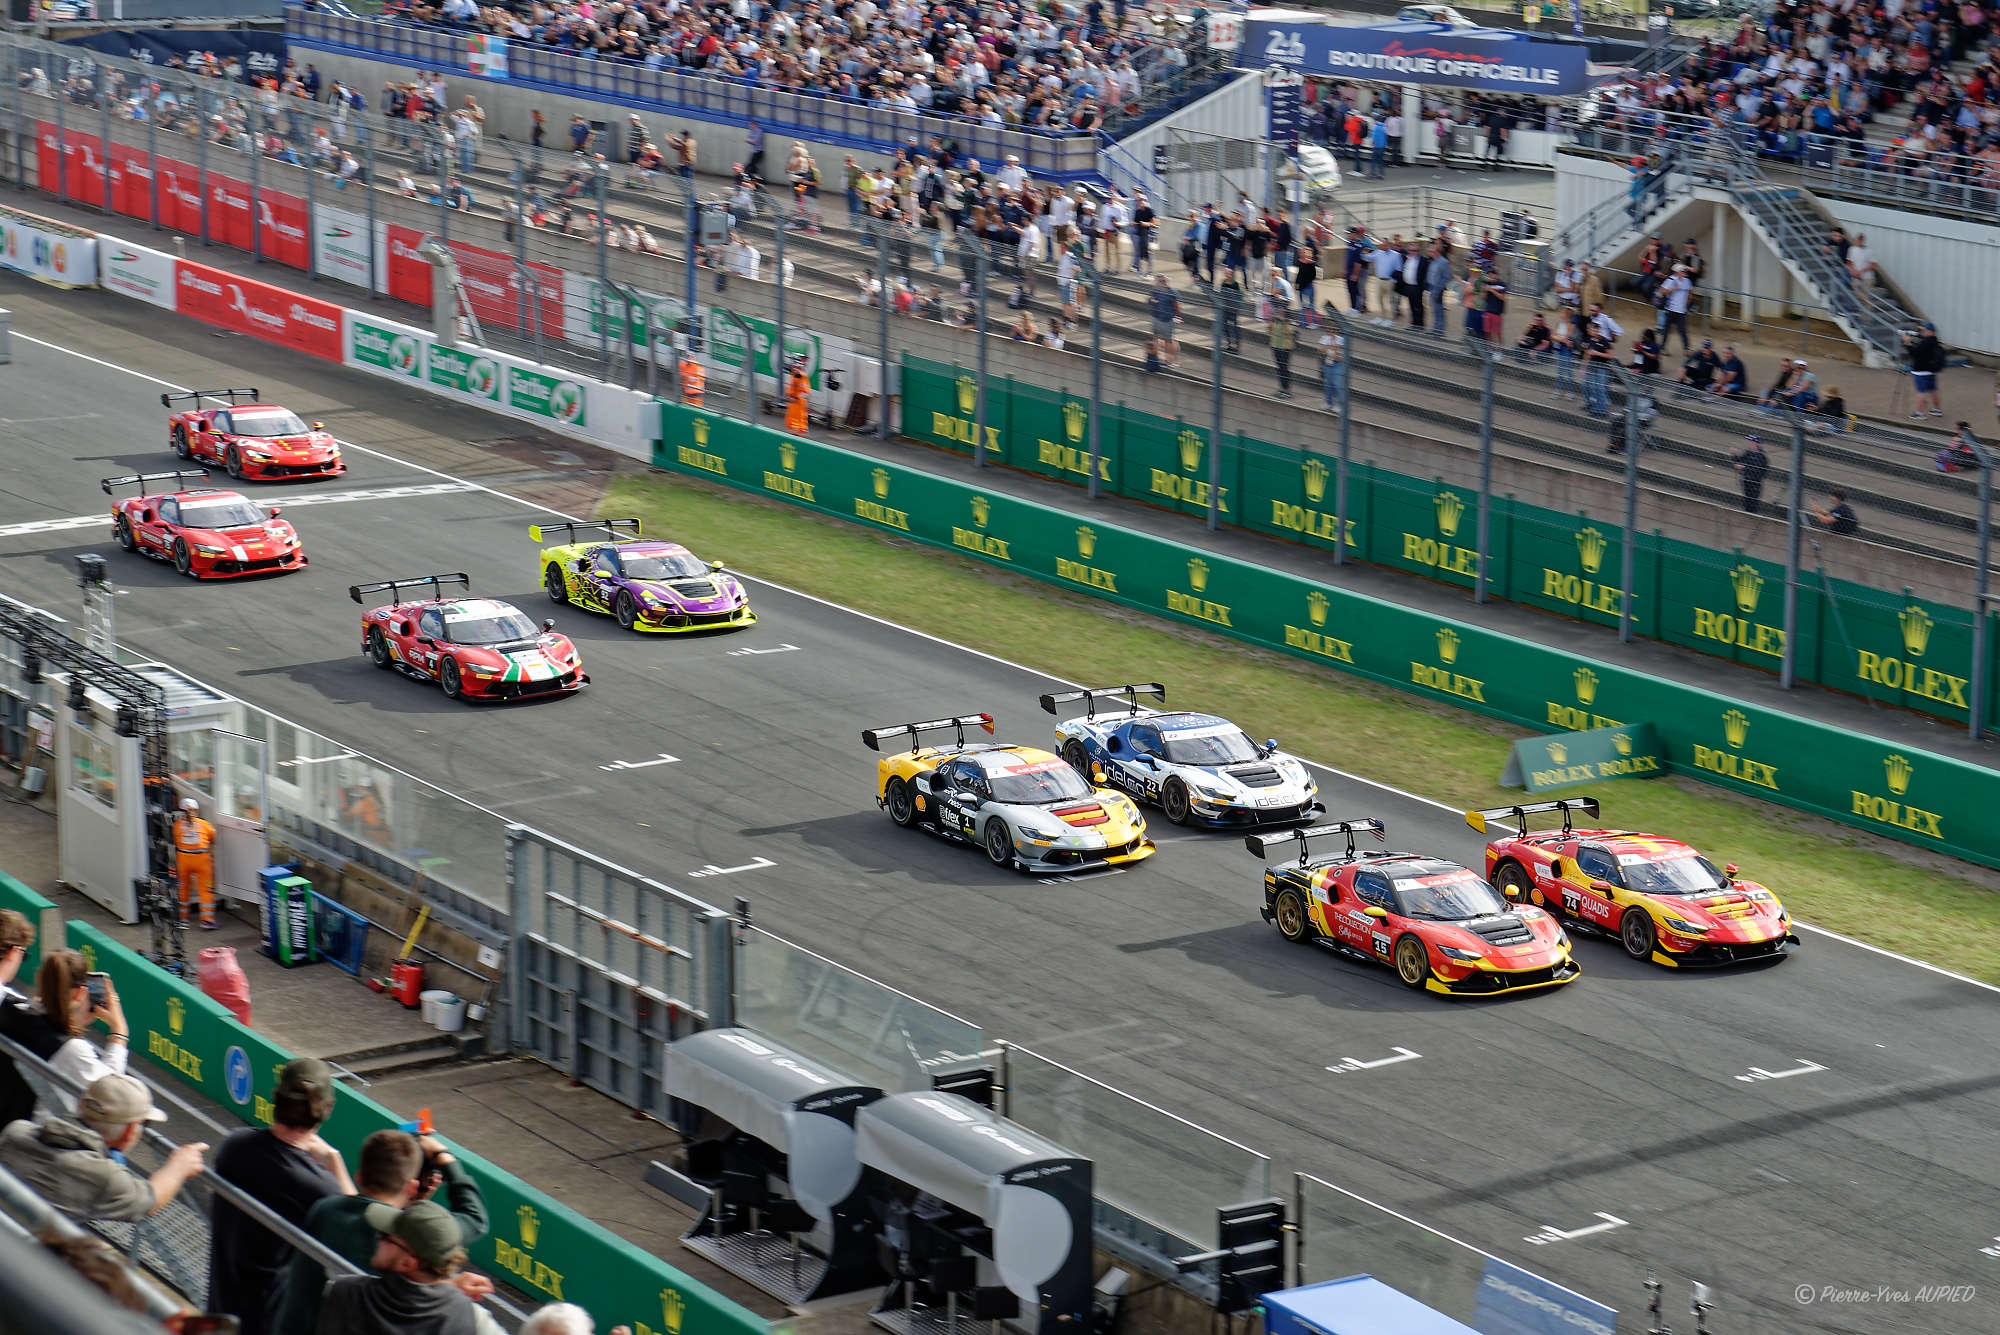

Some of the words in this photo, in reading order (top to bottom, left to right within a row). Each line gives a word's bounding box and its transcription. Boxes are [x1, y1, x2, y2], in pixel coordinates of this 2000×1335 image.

[1328, 50, 1437, 74] BOUTIQUE
[1437, 57, 1560, 85] OFFICIELLE
[677, 445, 728, 477] ROLEX
[763, 470, 817, 503] ROLEX
[855, 497, 911, 532] ROLEX
[952, 526, 1012, 561] ROLEX
[1402, 532, 1493, 582] ROLE
[1056, 556, 1119, 594] ROLEX
[1166, 588, 1233, 628] ROLEX
[1543, 567, 1639, 622] ROLE
[1283, 624, 1354, 665] ROLEX
[1410, 661, 1487, 703] ROLEX
[1857, 649, 1969, 710] ROLEX
[1531, 764, 1596, 787] ROLEX
[1598, 755, 1661, 777] ROLEX
[1692, 743, 1780, 791] ROLEX
[1146, 780, 1156, 793] 22
[964, 816, 970, 827] 1
[1851, 790, 1944, 839] ROLEX
[1565, 895, 1577, 911] 74
[1581, 895, 1609, 919] QUADIS
[1375, 940, 1387, 954] 15
[148, 1029, 203, 1083] ROLEX
[494, 1237, 565, 1301] ROLEX
